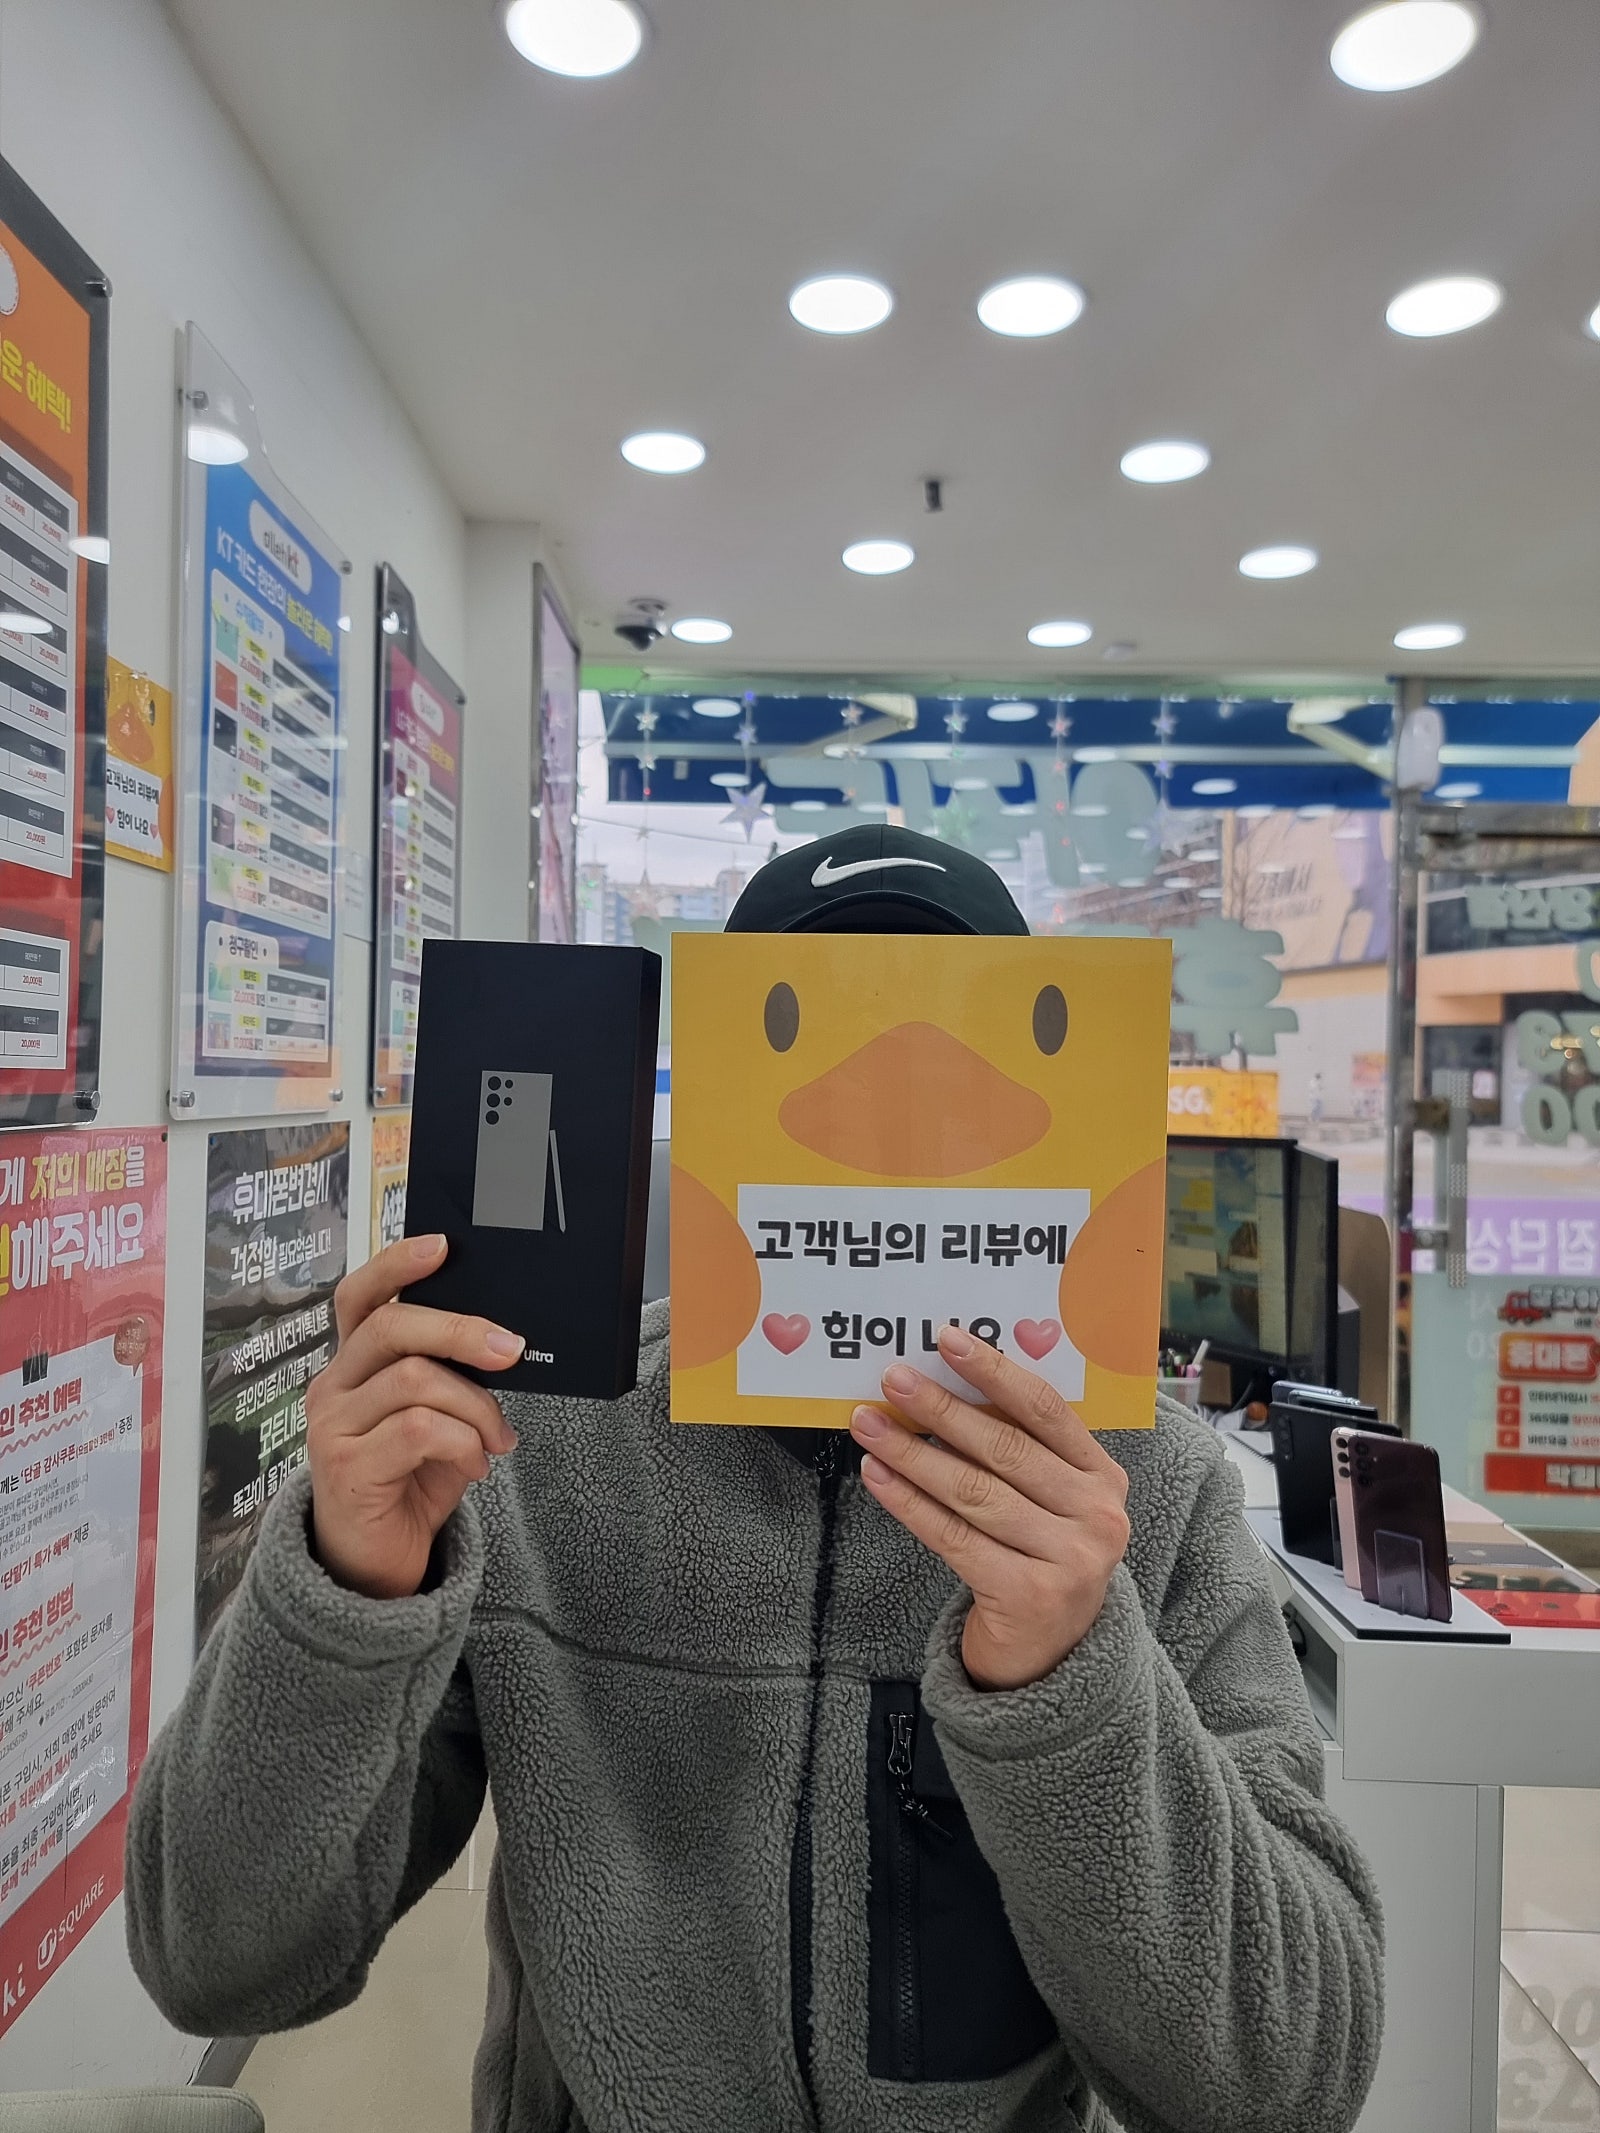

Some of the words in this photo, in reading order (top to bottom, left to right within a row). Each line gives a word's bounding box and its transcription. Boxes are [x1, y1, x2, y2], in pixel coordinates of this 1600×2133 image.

[0, 339, 24, 393] 운
[26, 361, 72, 434] 혜택!
[106, 768, 137, 796] 고객님의
[138, 782, 160, 806] 리뷰에
[117, 808, 133, 830] 힘이
[135, 816, 149, 836] 나요
[229, 934, 259, 961] 청구할인
[22, 974, 43, 987] 20,000원
[21, 1038, 42, 1050] 20,000원
[30, 1151, 80, 1201] 저희
[85, 1145, 145, 1193] 매장을
[233, 1159, 331, 1225] 휴대폰변경시
[230, 1236, 278, 1287] 걱정할
[278, 1228, 332, 1271] 필요없습니다!
[755, 1220, 926, 1267] 고객님의
[941, 1223, 1067, 1267] 리뷰에
[524, 1350, 554, 1363] Ultra
[821, 1310, 906, 1360] 힘이
[19, 1390, 50, 1428] 추천
[53, 1377, 82, 1414] 혜택
[119, 1414, 133, 1435] 증정
[233, 1474, 265, 1518] 똑같이
[34, 1544, 52, 1569] 특가
[73, 1522, 90, 1544] 제공
[13, 1604, 44, 1649] 추천
[47, 1582, 74, 1627] 방법
[65, 1631, 89, 1662] 포함된
[91, 1612, 113, 1644] 문자를
[0, 1780, 12, 1803] 폰
[14, 1754, 42, 1790] 구입시,
[44, 1737, 60, 1763] 저희
[62, 1713, 86, 1746] 매장에
[88, 1685, 116, 1726] 방문하여
[20, 1773, 53, 1809] 직원에게
[54, 1743, 79, 1777] 제시해
[80, 1722, 103, 1753] 주세요
[0, 1845, 19, 1877] 폰을
[21, 1826, 38, 1854] 최종
[21, 1850, 38, 1877] 각각
[58, 1874, 105, 1942] SQUARE
